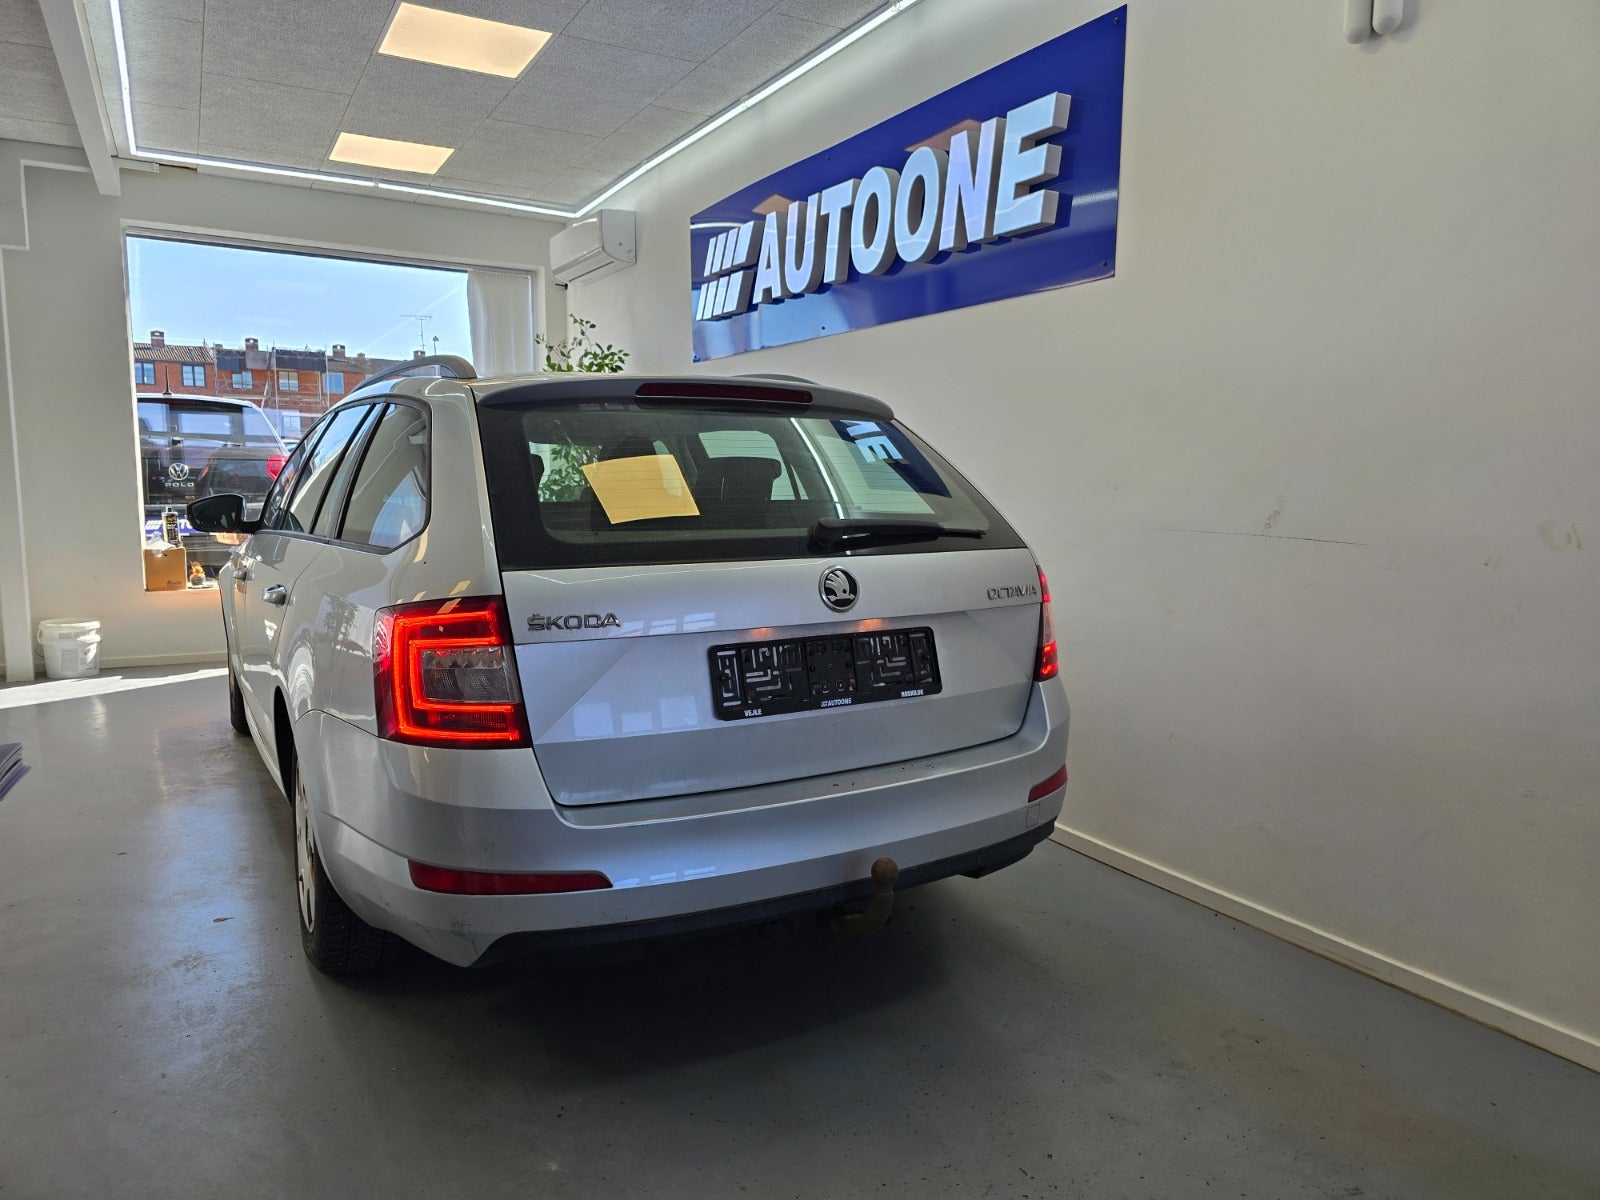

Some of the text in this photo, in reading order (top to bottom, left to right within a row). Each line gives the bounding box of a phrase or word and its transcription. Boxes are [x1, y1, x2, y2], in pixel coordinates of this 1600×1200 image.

[752, 92, 1071, 305] AUTOONE
[987, 585, 1037, 600] OCTAVIA
[828, 697, 852, 707] AUTOONE
[743, 708, 763, 717] VEJLE
